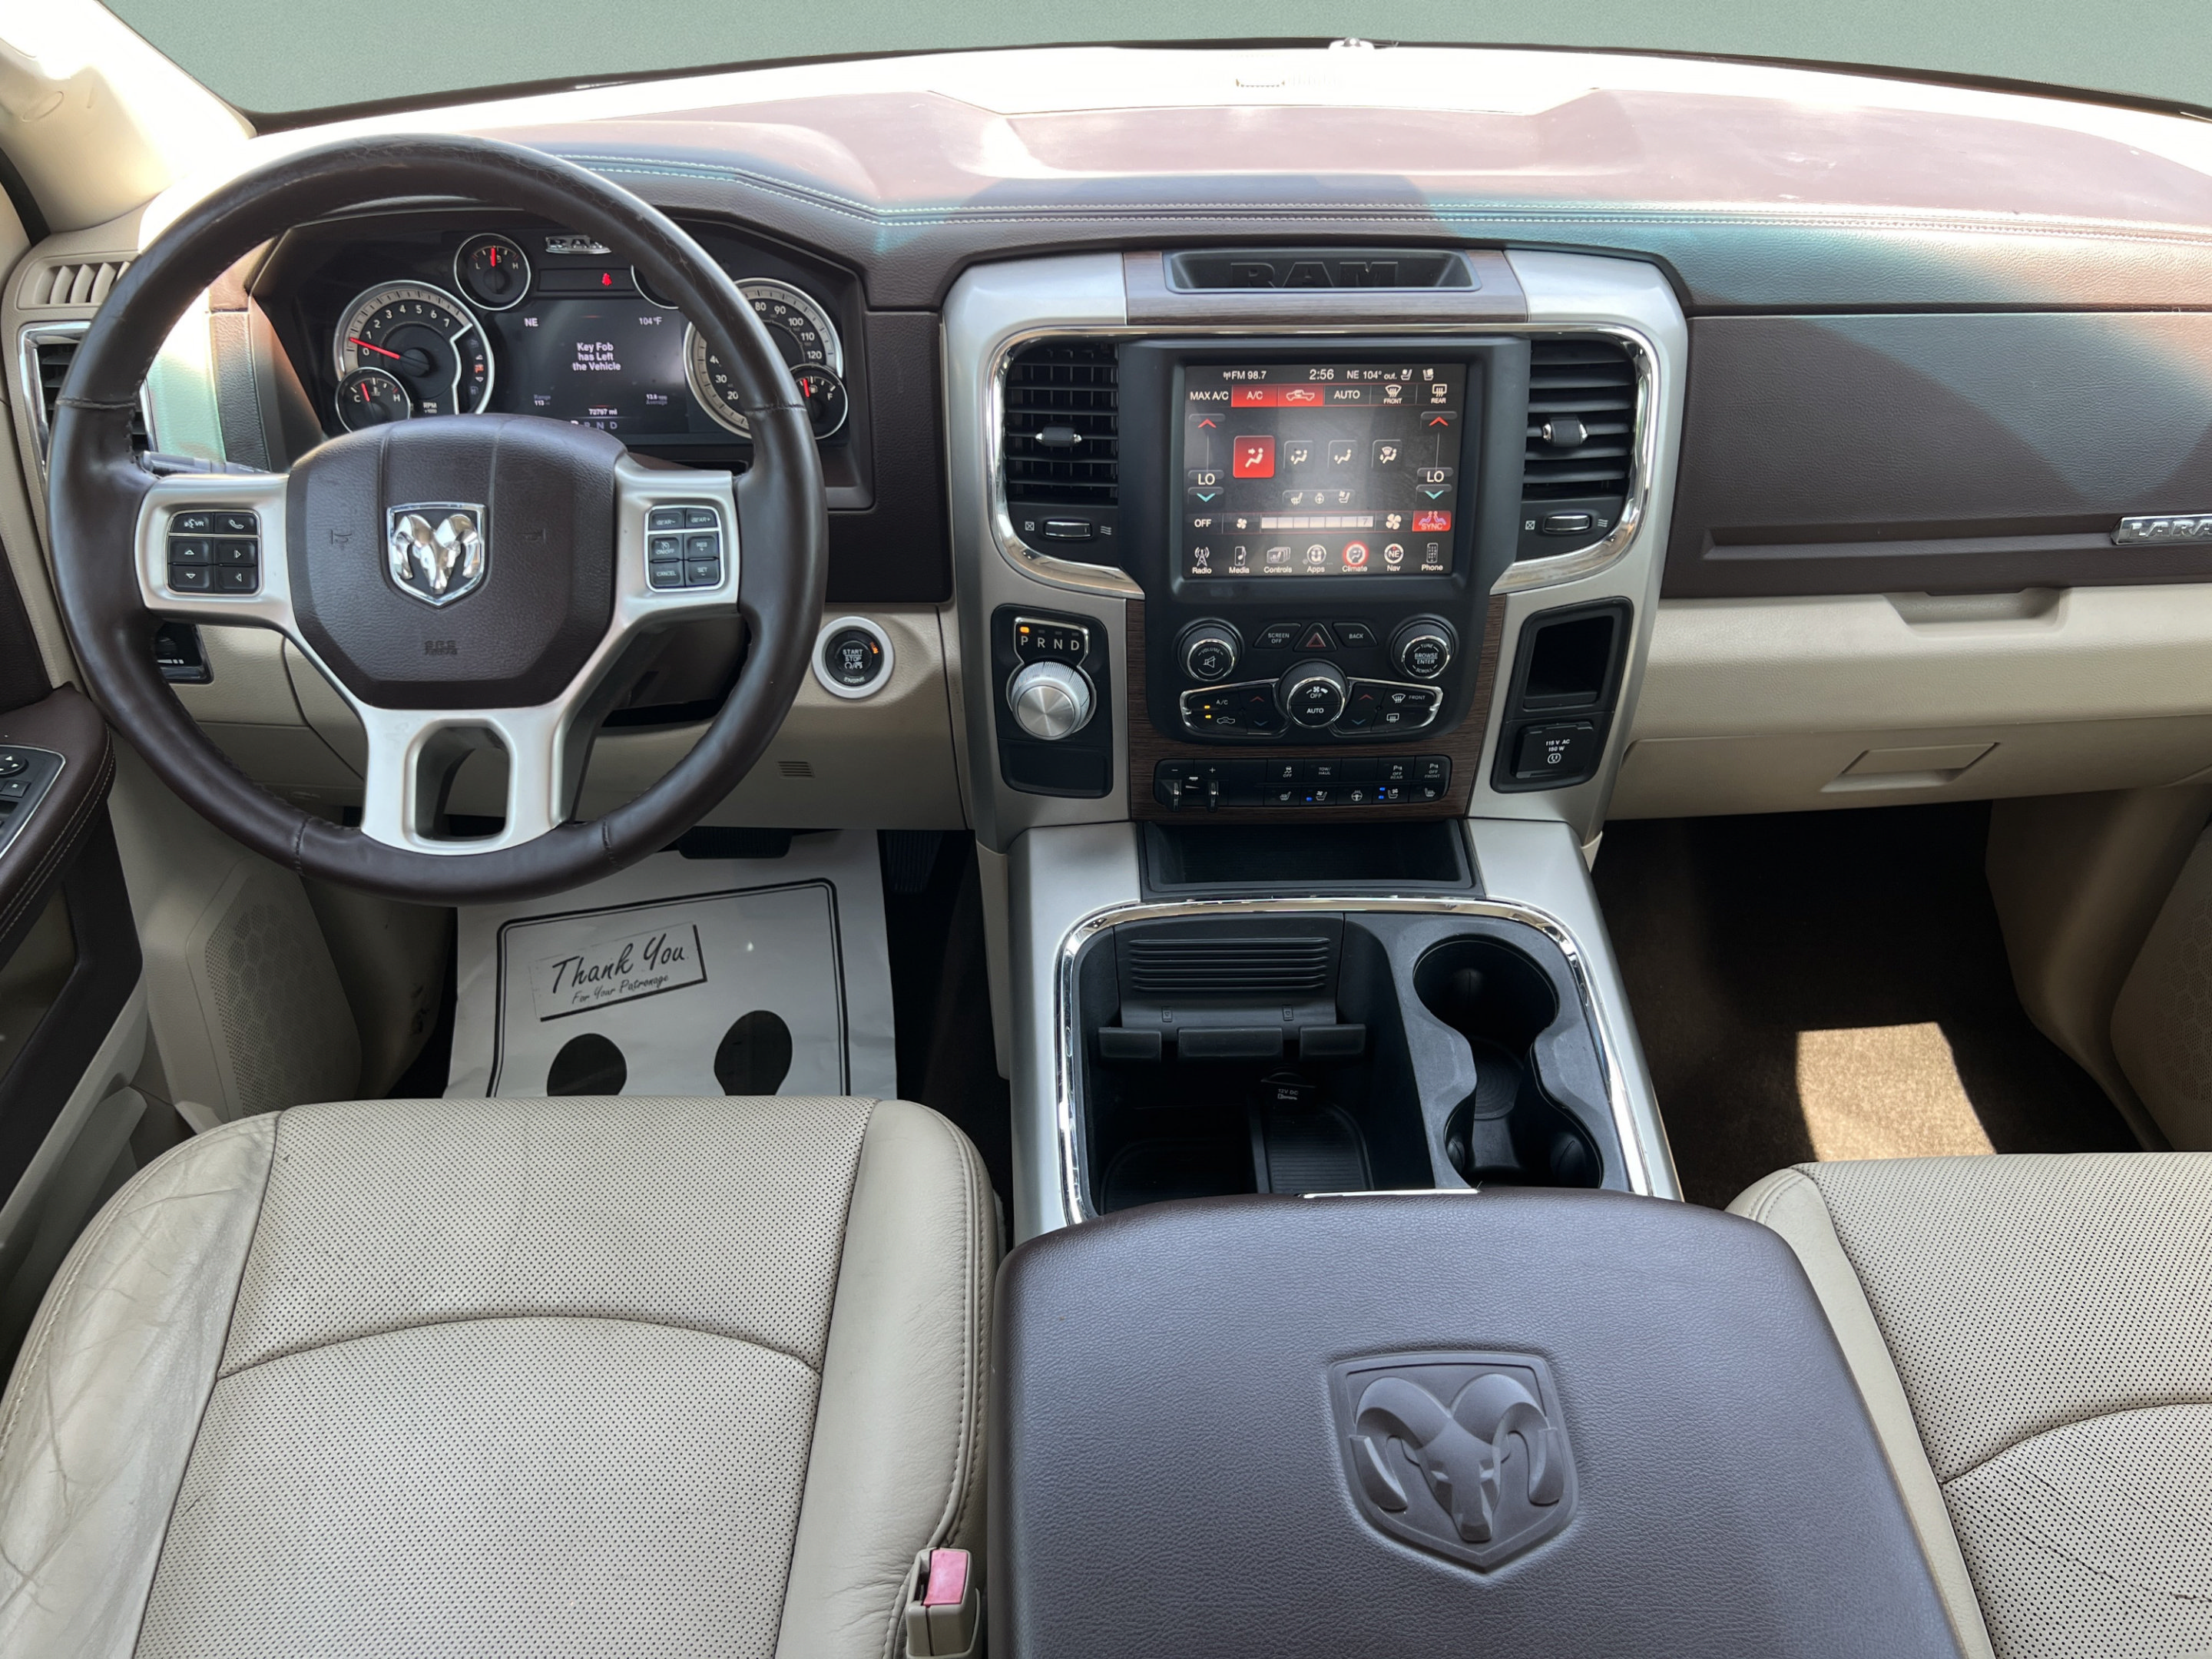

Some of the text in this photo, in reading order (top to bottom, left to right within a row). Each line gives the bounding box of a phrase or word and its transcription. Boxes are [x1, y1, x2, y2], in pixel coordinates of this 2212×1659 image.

[1230, 261, 1399, 288] RAM
[399, 305, 406, 313] 4
[416, 305, 422, 313] 5
[754, 302, 767, 311] 80
[774, 306, 786, 315] 90
[431, 310, 437, 319] 6
[374, 320, 381, 329] 2
[444, 319, 449, 327] 7
[524, 318, 538, 326] NE
[366, 331, 372, 339] 1
[800, 332, 815, 341] 110
[577, 343, 614, 353] Key Fob
[578, 352, 614, 361] has Left
[806, 351, 822, 359] 120
[572, 363, 621, 371] the Vehicle
[715, 375, 727, 383] 30
[1231, 370, 1267, 379] FM 98.7
[1309, 369, 1334, 380] 2:56
[1346, 370, 1359, 379] NE
[727, 391, 739, 400] 20
[1190, 392, 1229, 400] MAX A/C
[1247, 391, 1263, 399] A/C
[1333, 390, 1360, 399] AUTO
[1197, 473, 1215, 485] LO
[1426, 471, 1445, 482] LO
[1194, 519, 1212, 528] OFF
[1306, 565, 1326, 574] Apps
[1021, 635, 1080, 651] P R N D
[552, 932, 685, 993] Thank You
[572, 975, 669, 1005] For Your Patronage
